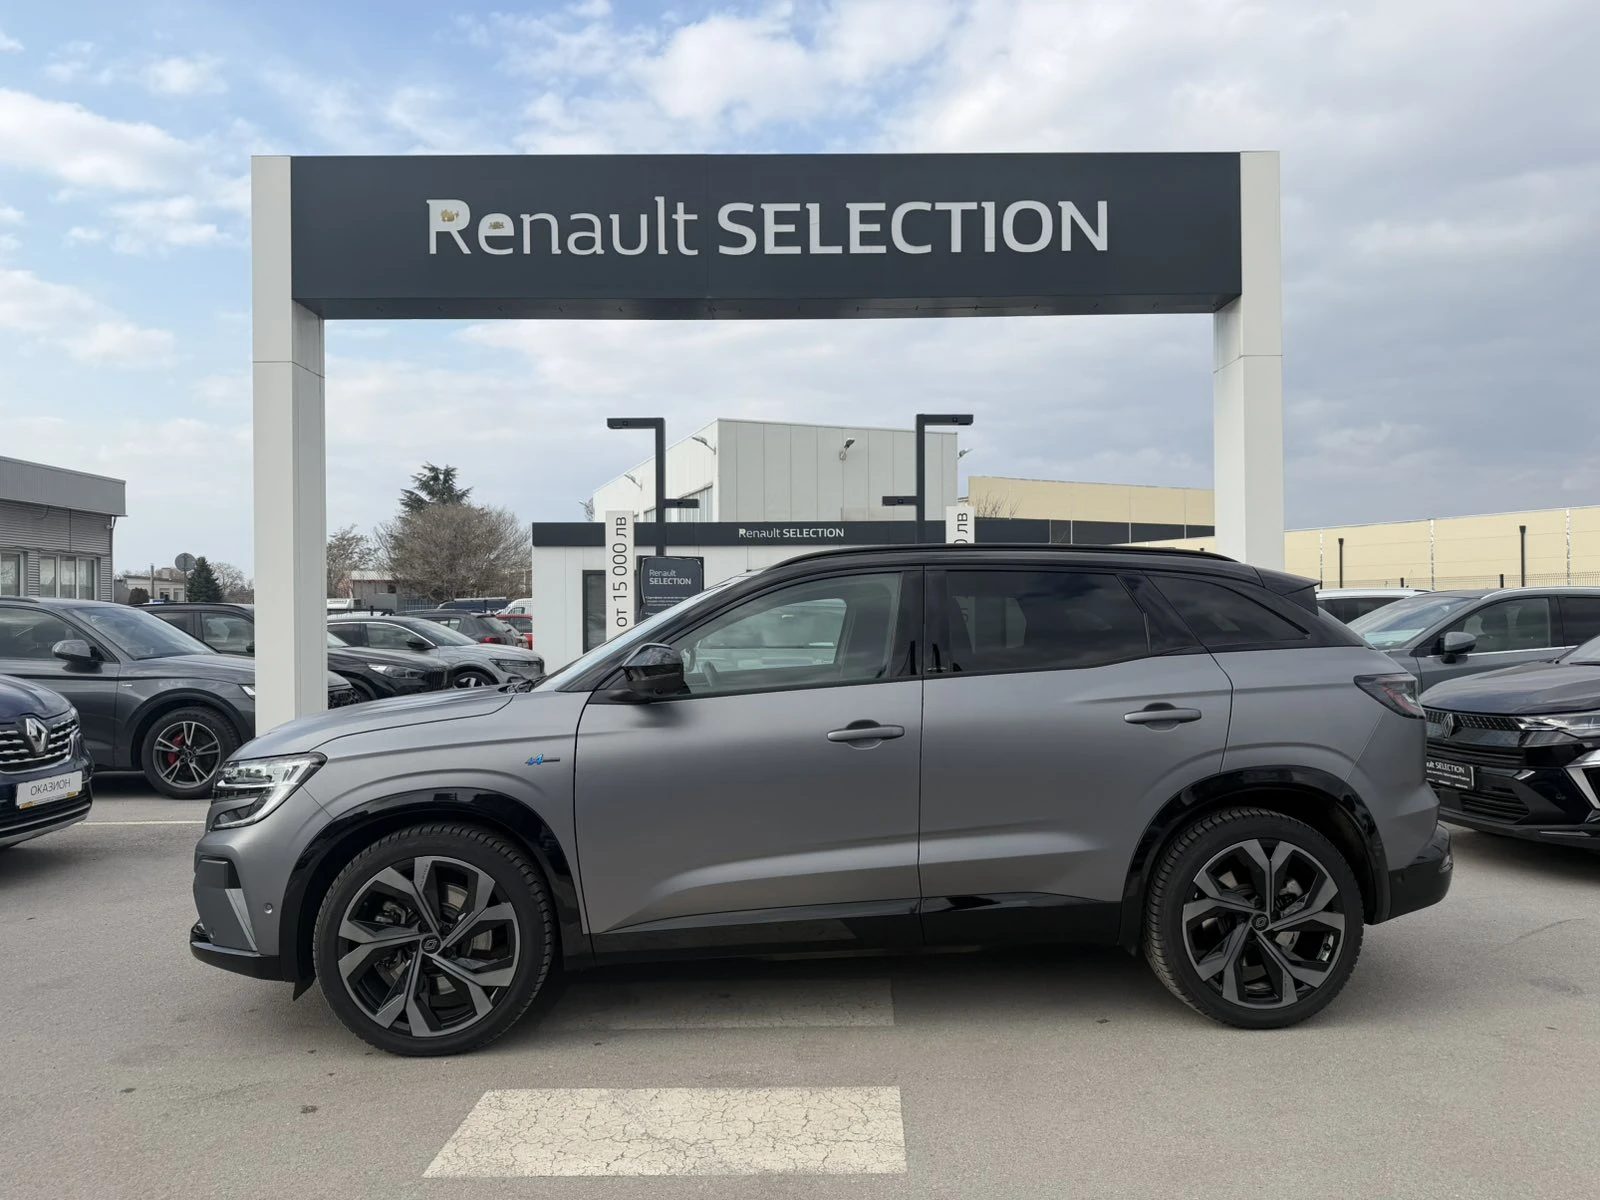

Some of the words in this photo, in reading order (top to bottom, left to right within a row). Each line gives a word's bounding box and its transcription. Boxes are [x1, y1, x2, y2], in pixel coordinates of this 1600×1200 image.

[426, 196, 699, 256] Renault
[717, 200, 1108, 256] SELECTION
[738, 527, 781, 538] Renault
[782, 528, 845, 538] SELECTION
[612, 542, 628, 577] 000
[648, 569, 677, 577] Renault
[648, 577, 692, 585] SELECTION
[612, 581, 628, 602] 15
[1435, 761, 1465, 774] SELECTION
[30, 777, 71, 796] ОКАЗИОН
